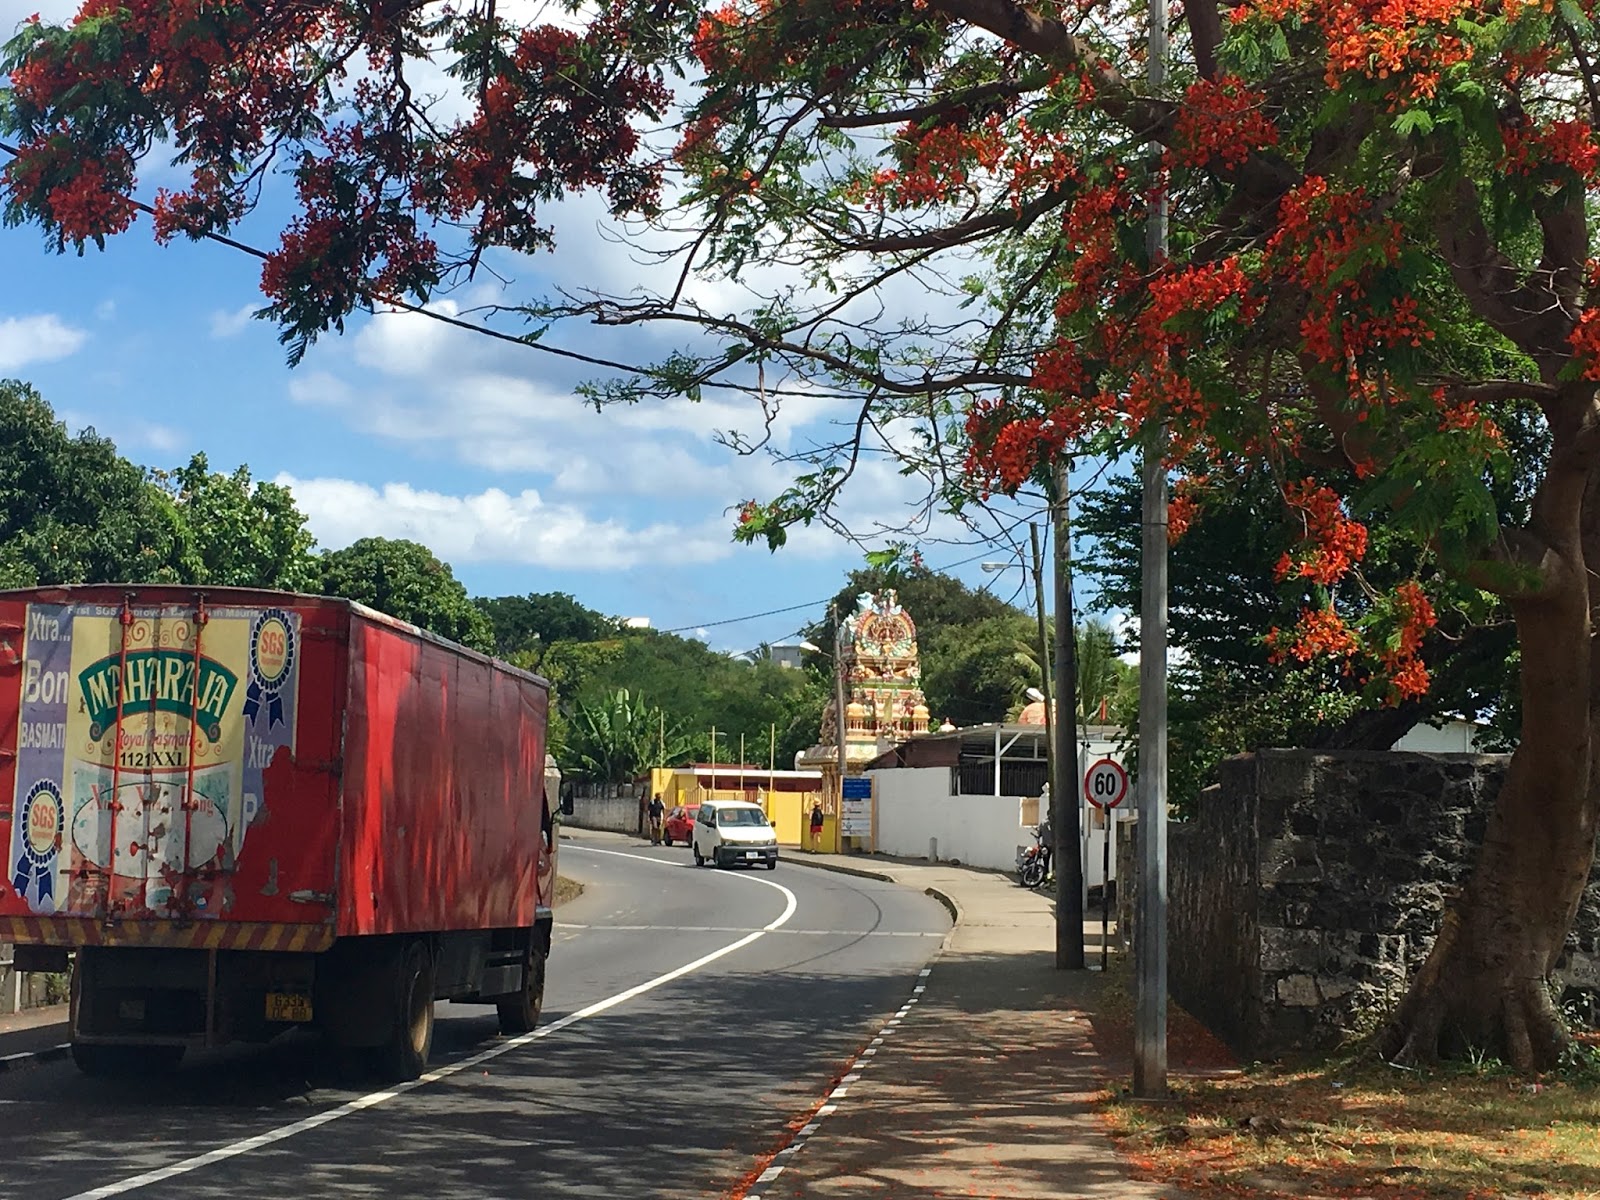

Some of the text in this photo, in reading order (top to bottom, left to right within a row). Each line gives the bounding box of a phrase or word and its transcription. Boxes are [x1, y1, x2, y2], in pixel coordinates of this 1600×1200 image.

[95, 606, 118, 616] SGS
[261, 631, 285, 656] SGS
[25, 659, 69, 705] Bon
[87, 656, 230, 717] MAHARAJA
[21, 722, 66, 750] BASMATI
[1094, 772, 1116, 796] 60
[32, 803, 55, 829] SGS
